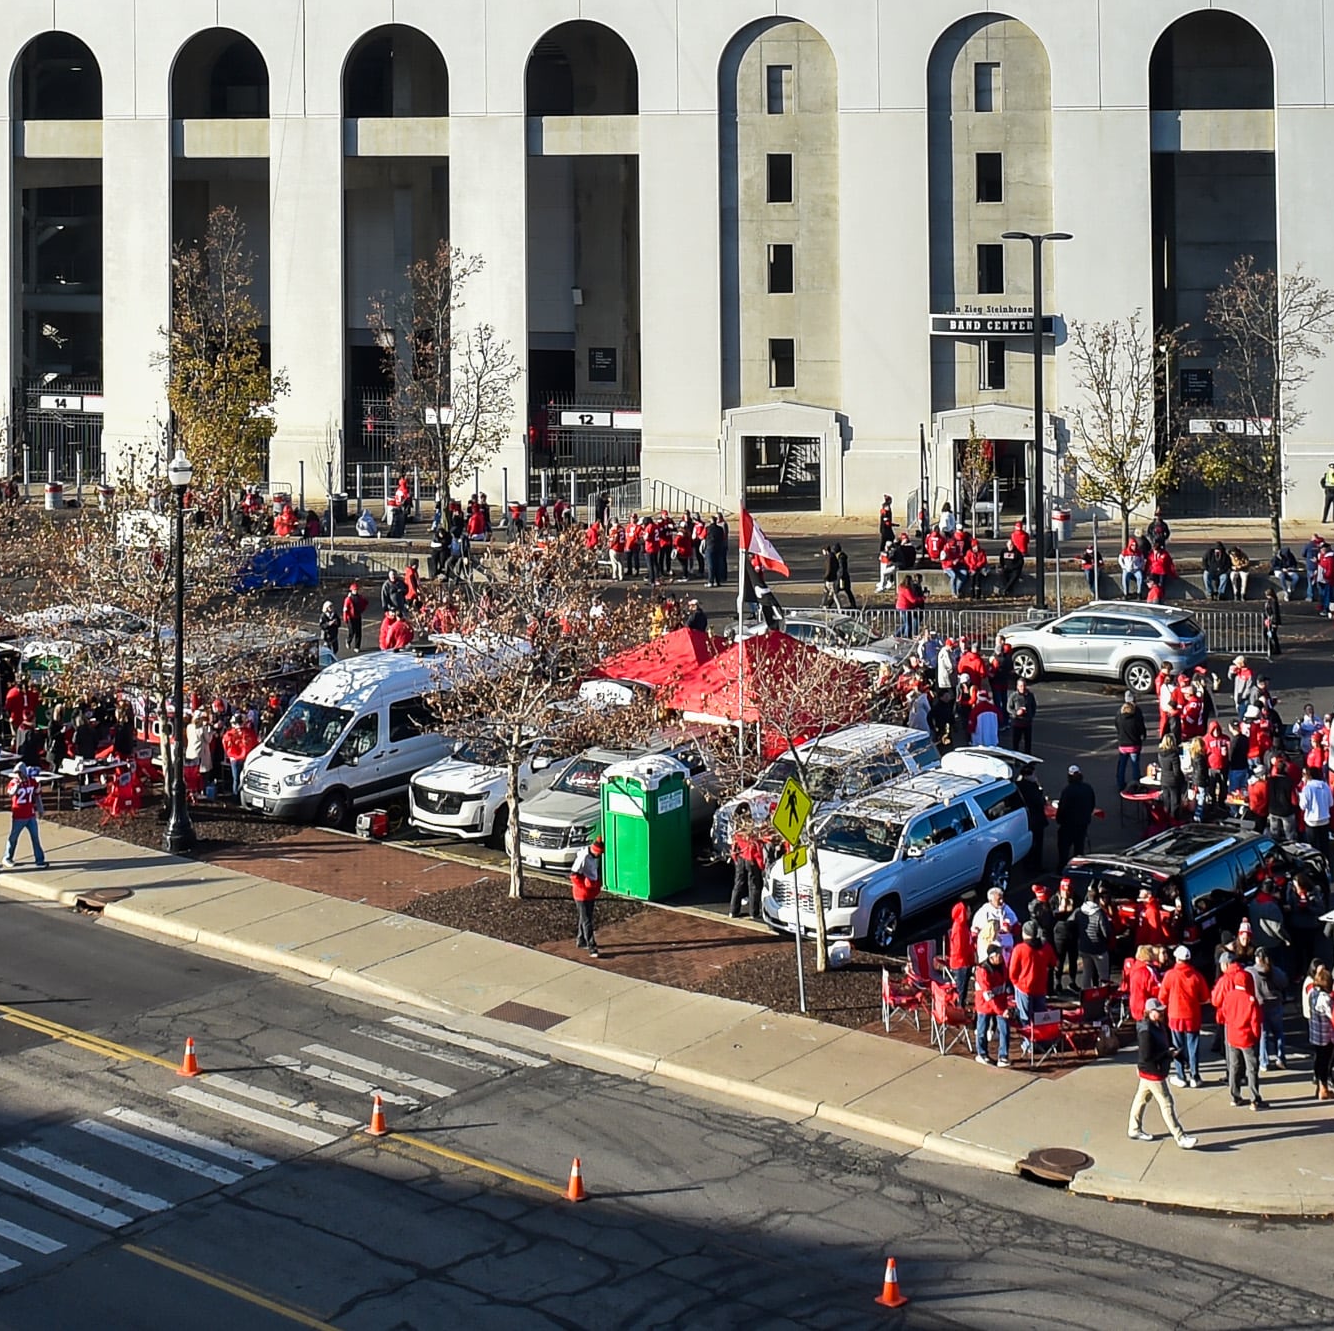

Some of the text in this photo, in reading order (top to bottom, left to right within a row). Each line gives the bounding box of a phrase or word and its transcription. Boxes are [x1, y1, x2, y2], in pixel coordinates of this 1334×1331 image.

[986, 305, 1034, 314] Steinbrenn
[949, 320, 1034, 330] BAND CENTER
[55, 398, 67, 408] 14
[579, 414, 594, 425] 12
[17, 787, 35, 804] 27
